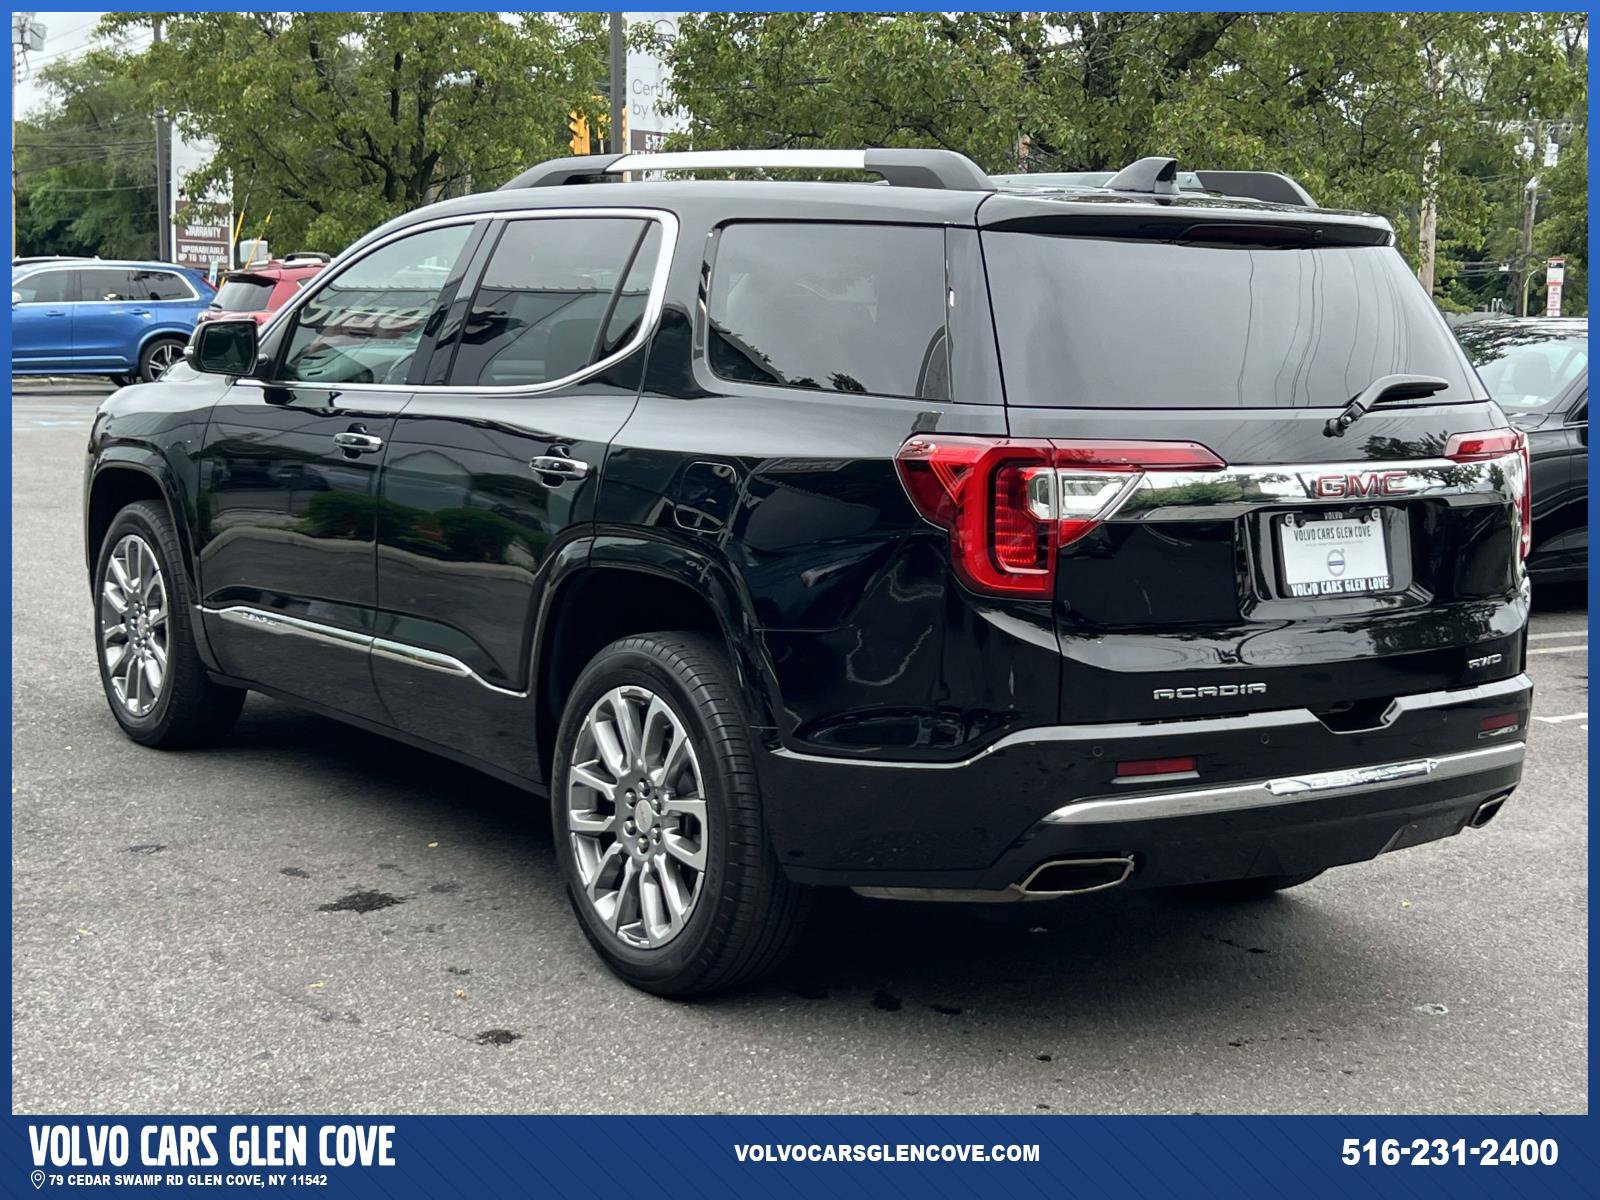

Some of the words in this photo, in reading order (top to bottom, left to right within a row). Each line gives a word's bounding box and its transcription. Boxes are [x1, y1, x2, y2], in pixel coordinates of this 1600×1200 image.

[632, 100, 649, 120] by
[178, 253, 187, 261] UP
[189, 253, 198, 262] TO
[199, 254, 207, 263] 10
[1317, 471, 1408, 498] GMC
[1324, 512, 1343, 520] VOLVO
[1294, 529, 1316, 541] VOLVO
[1317, 527, 1335, 540] CARS
[1336, 526, 1354, 539] GLEN
[1354, 525, 1372, 538] COVE
[1291, 582, 1319, 597] VOLVO
[1320, 580, 1344, 595] CARS
[1344, 578, 1367, 593] GLEN
[1468, 653, 1503, 670] AWD
[1152, 682, 1268, 701] ACADIA
